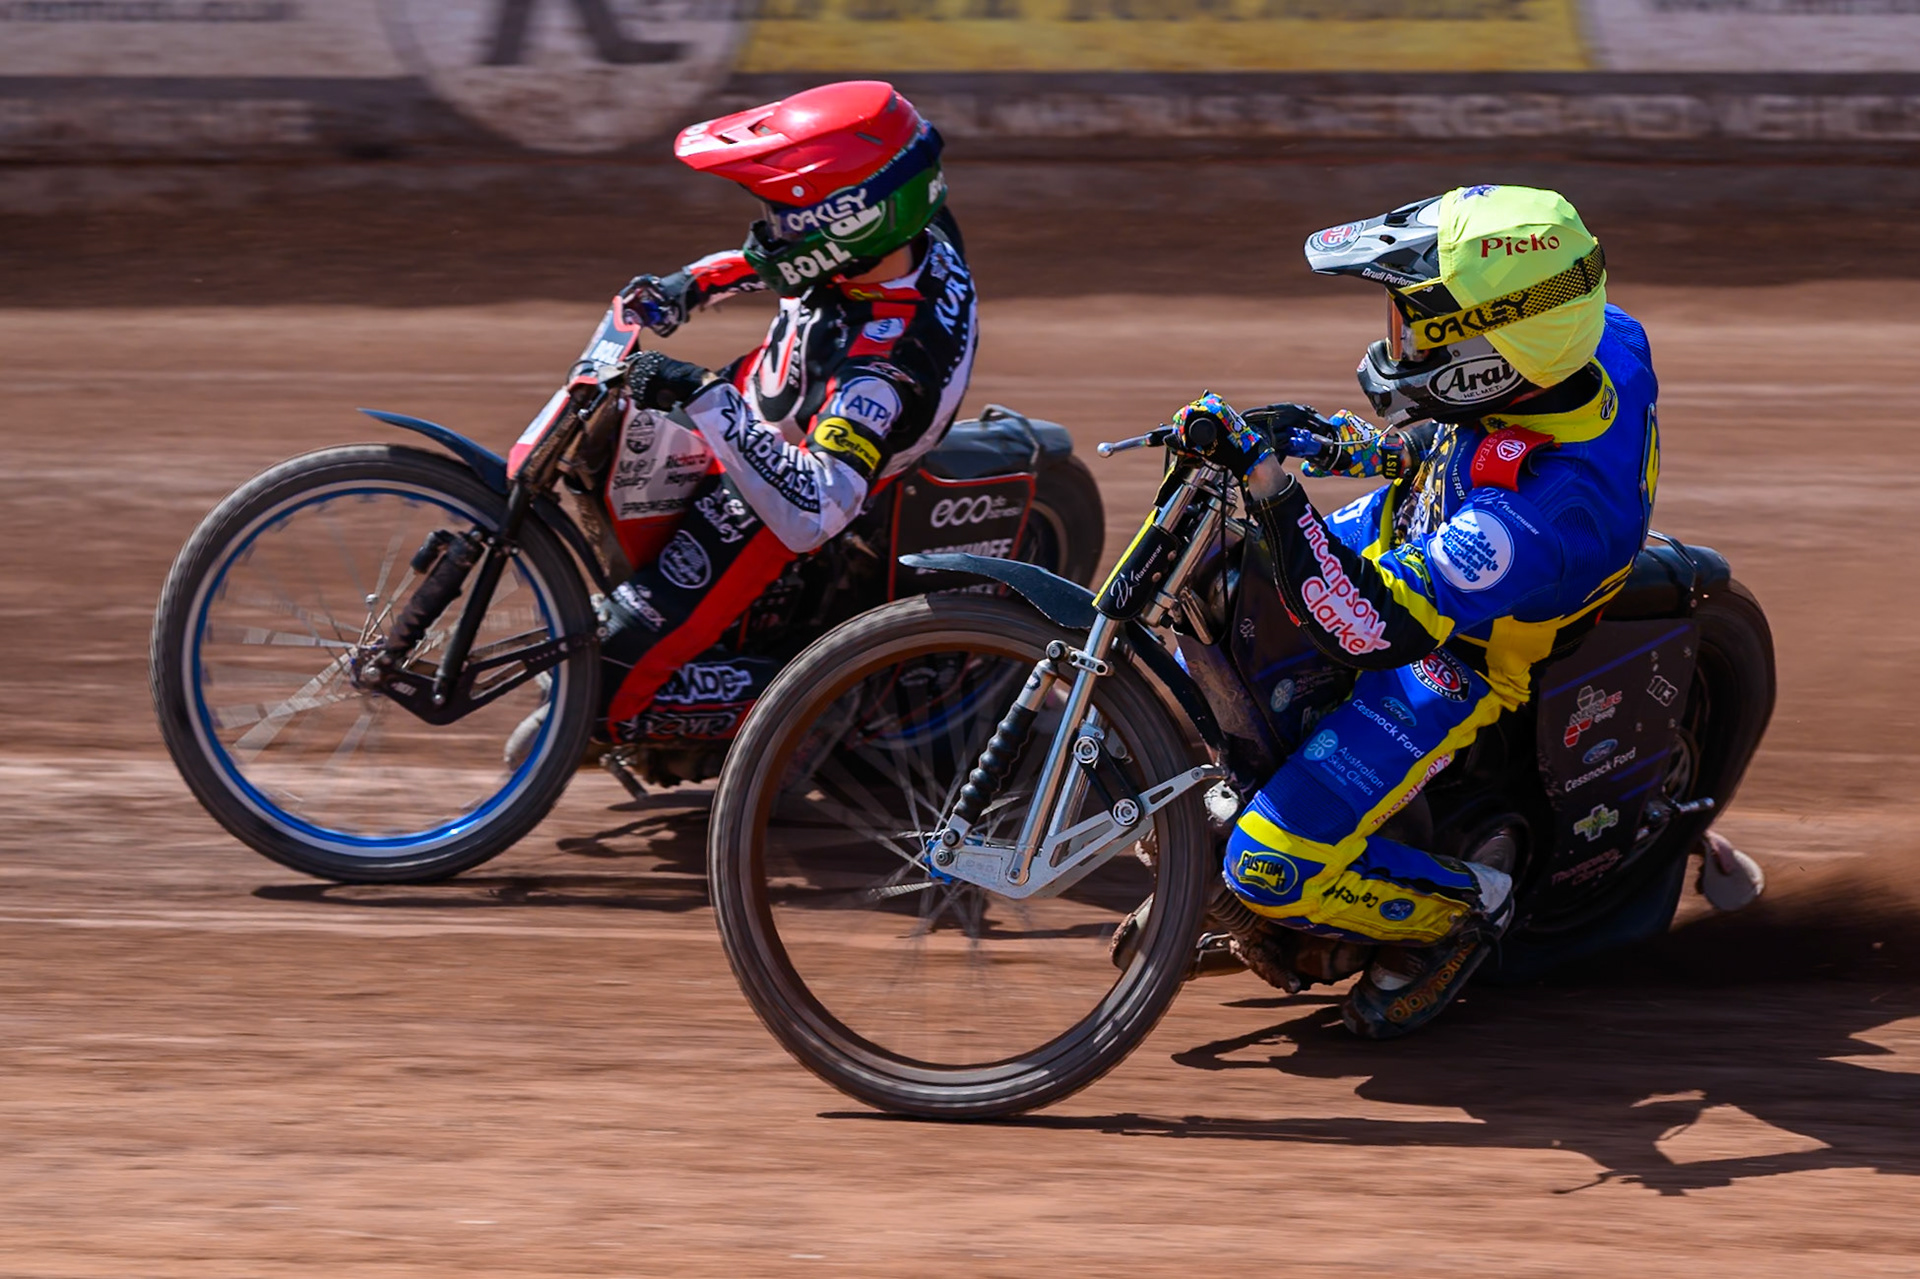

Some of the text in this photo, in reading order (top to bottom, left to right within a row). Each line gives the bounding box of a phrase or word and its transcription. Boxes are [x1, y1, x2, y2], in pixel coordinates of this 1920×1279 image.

[787, 188, 867, 232] OAKLEY
[777, 240, 852, 287] BOLL
[1480, 234, 1560, 258] Picko
[1424, 293, 1530, 344] OAKLEY
[1441, 357, 1513, 397] Arai
[1385, 454, 1398, 477] FIST
[1134, 543, 1164, 583] Racewear
[1303, 577, 1367, 653] Clarke
[1424, 658, 1454, 685] STS
[1352, 698, 1425, 760] Cessnock Ford
[1327, 754, 1375, 796] Skin Clinics
[1338, 746, 1384, 788] Australian
[1564, 761, 1612, 793] Cessnock
[1612, 746, 1637, 768] Ford
[1242, 853, 1285, 878] CUSTOM
